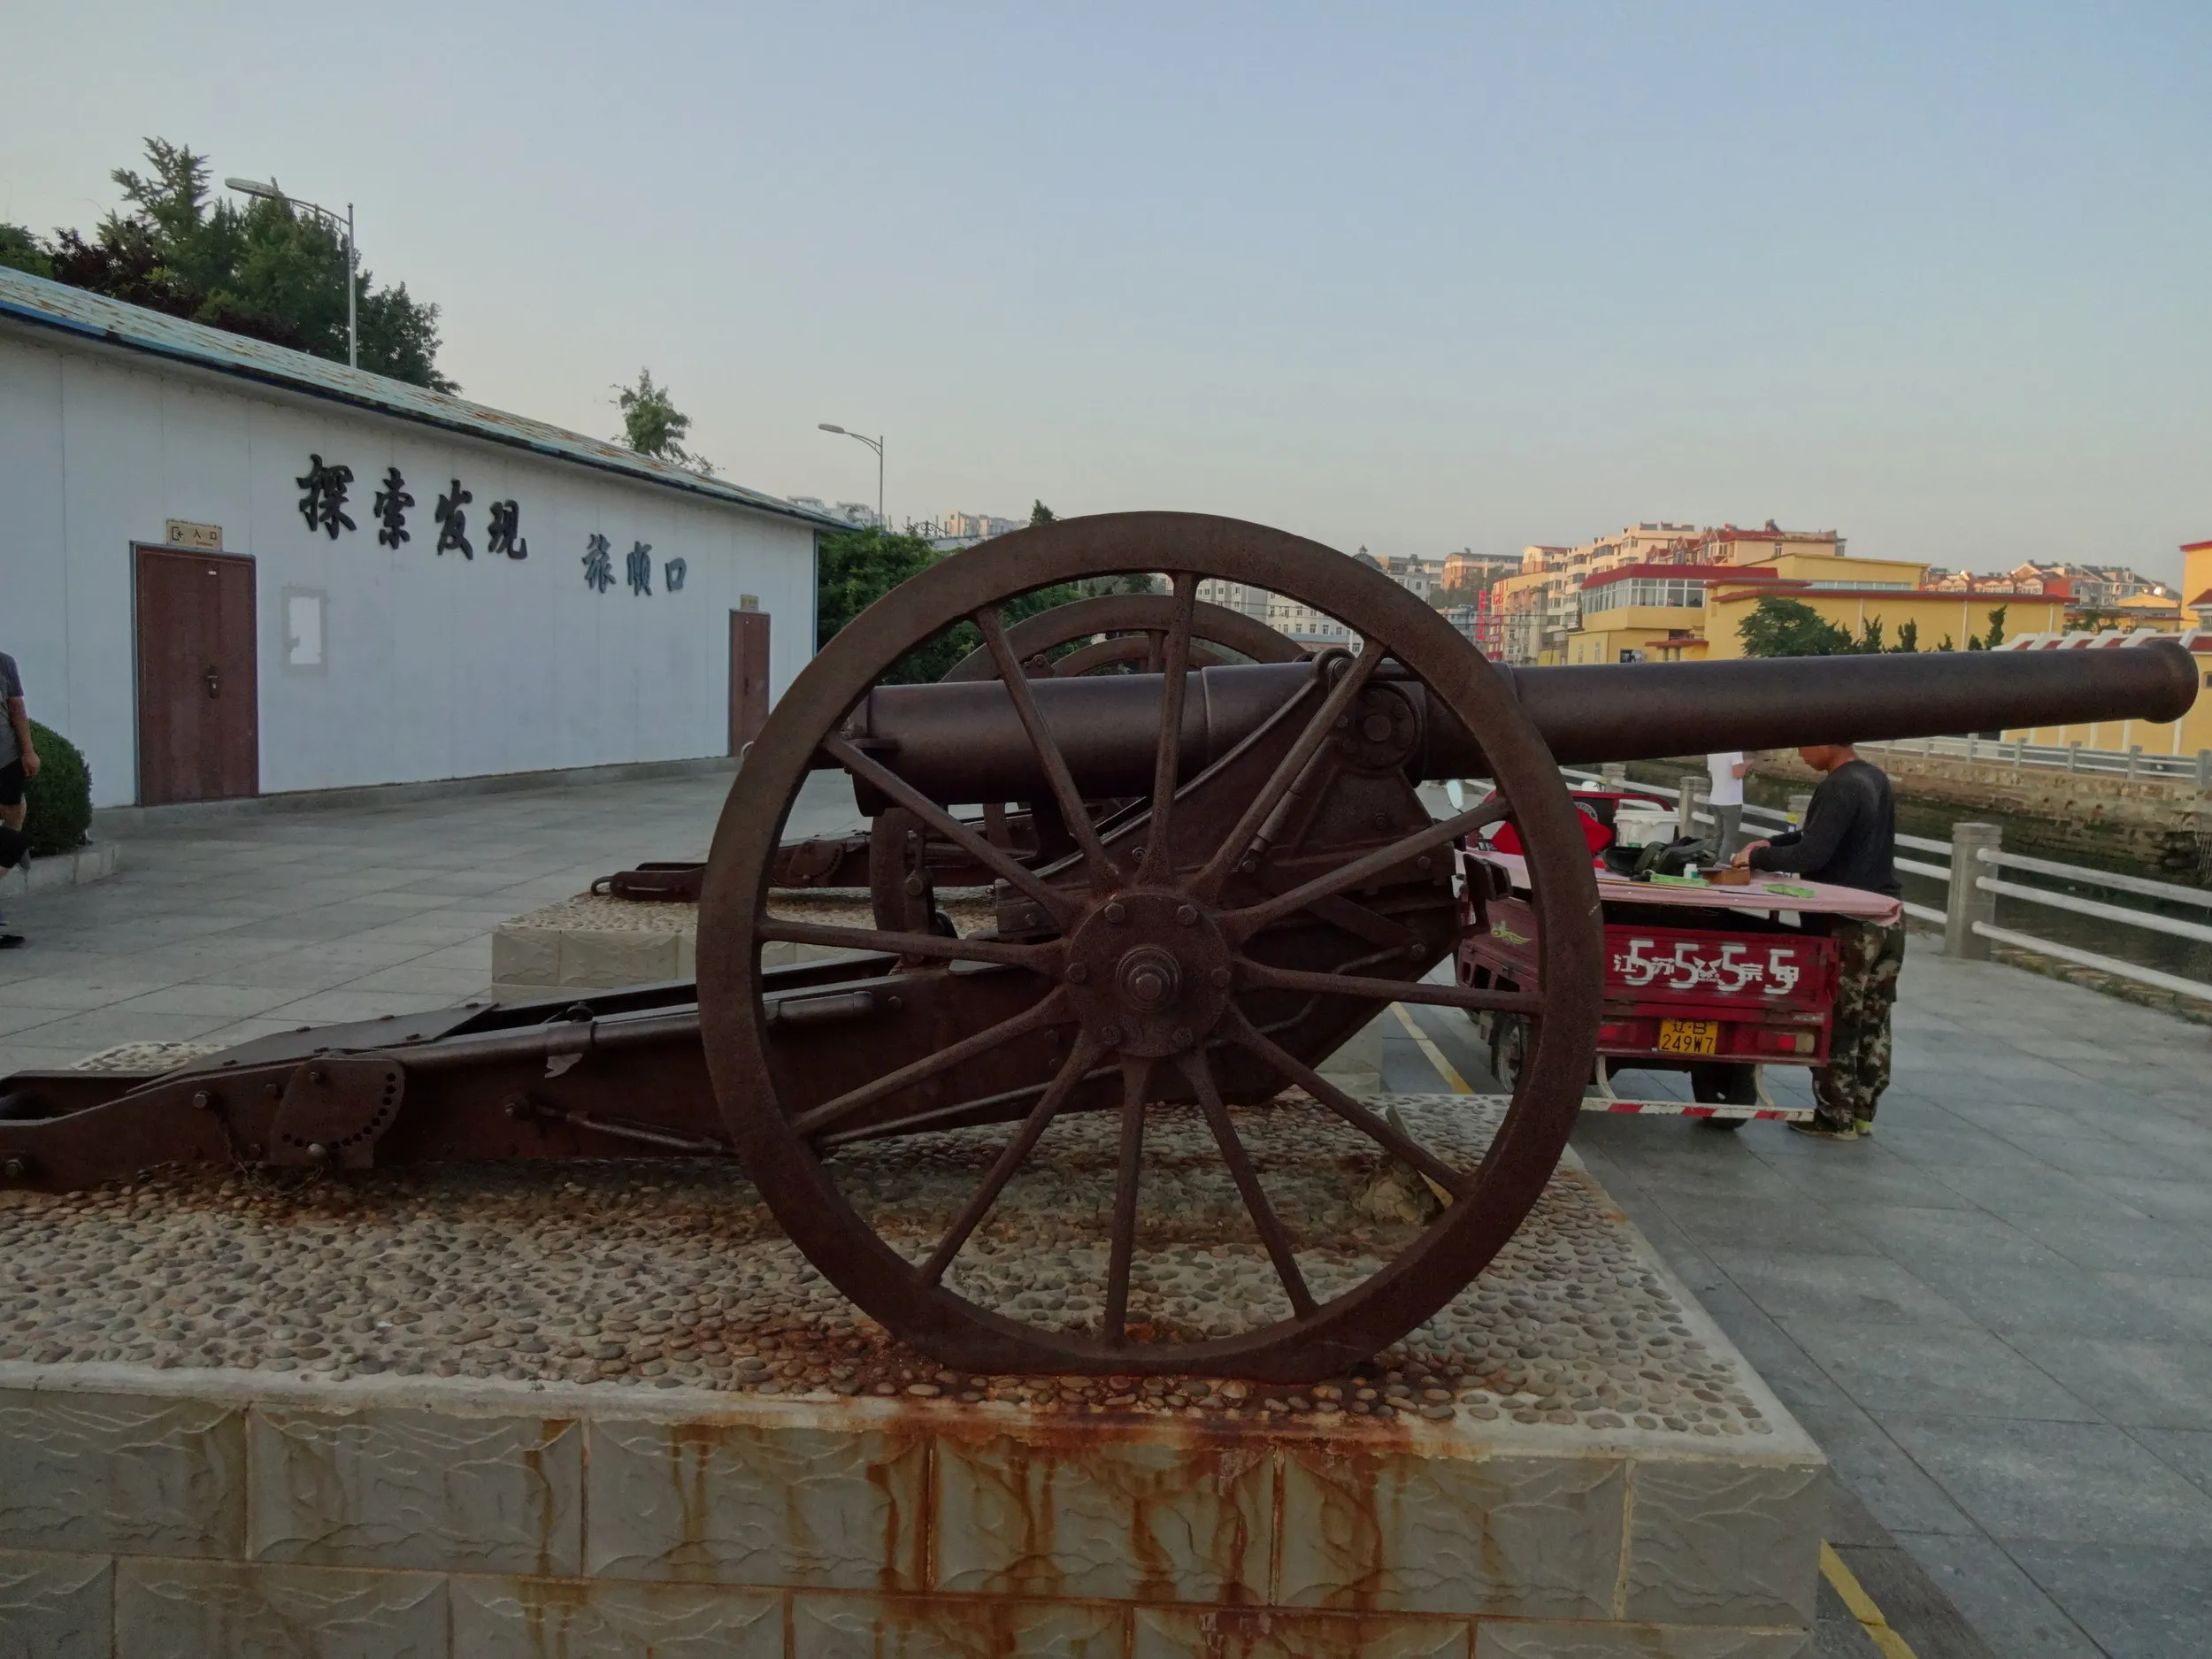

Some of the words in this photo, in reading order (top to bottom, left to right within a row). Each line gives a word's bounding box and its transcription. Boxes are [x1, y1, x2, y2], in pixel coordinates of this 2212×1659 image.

[296, 454, 528, 561] 探索发现
[193, 528, 218, 541] 入口
[1624, 940, 1795, 995] 5555
[1661, 1033, 1715, 1053] 249W7
